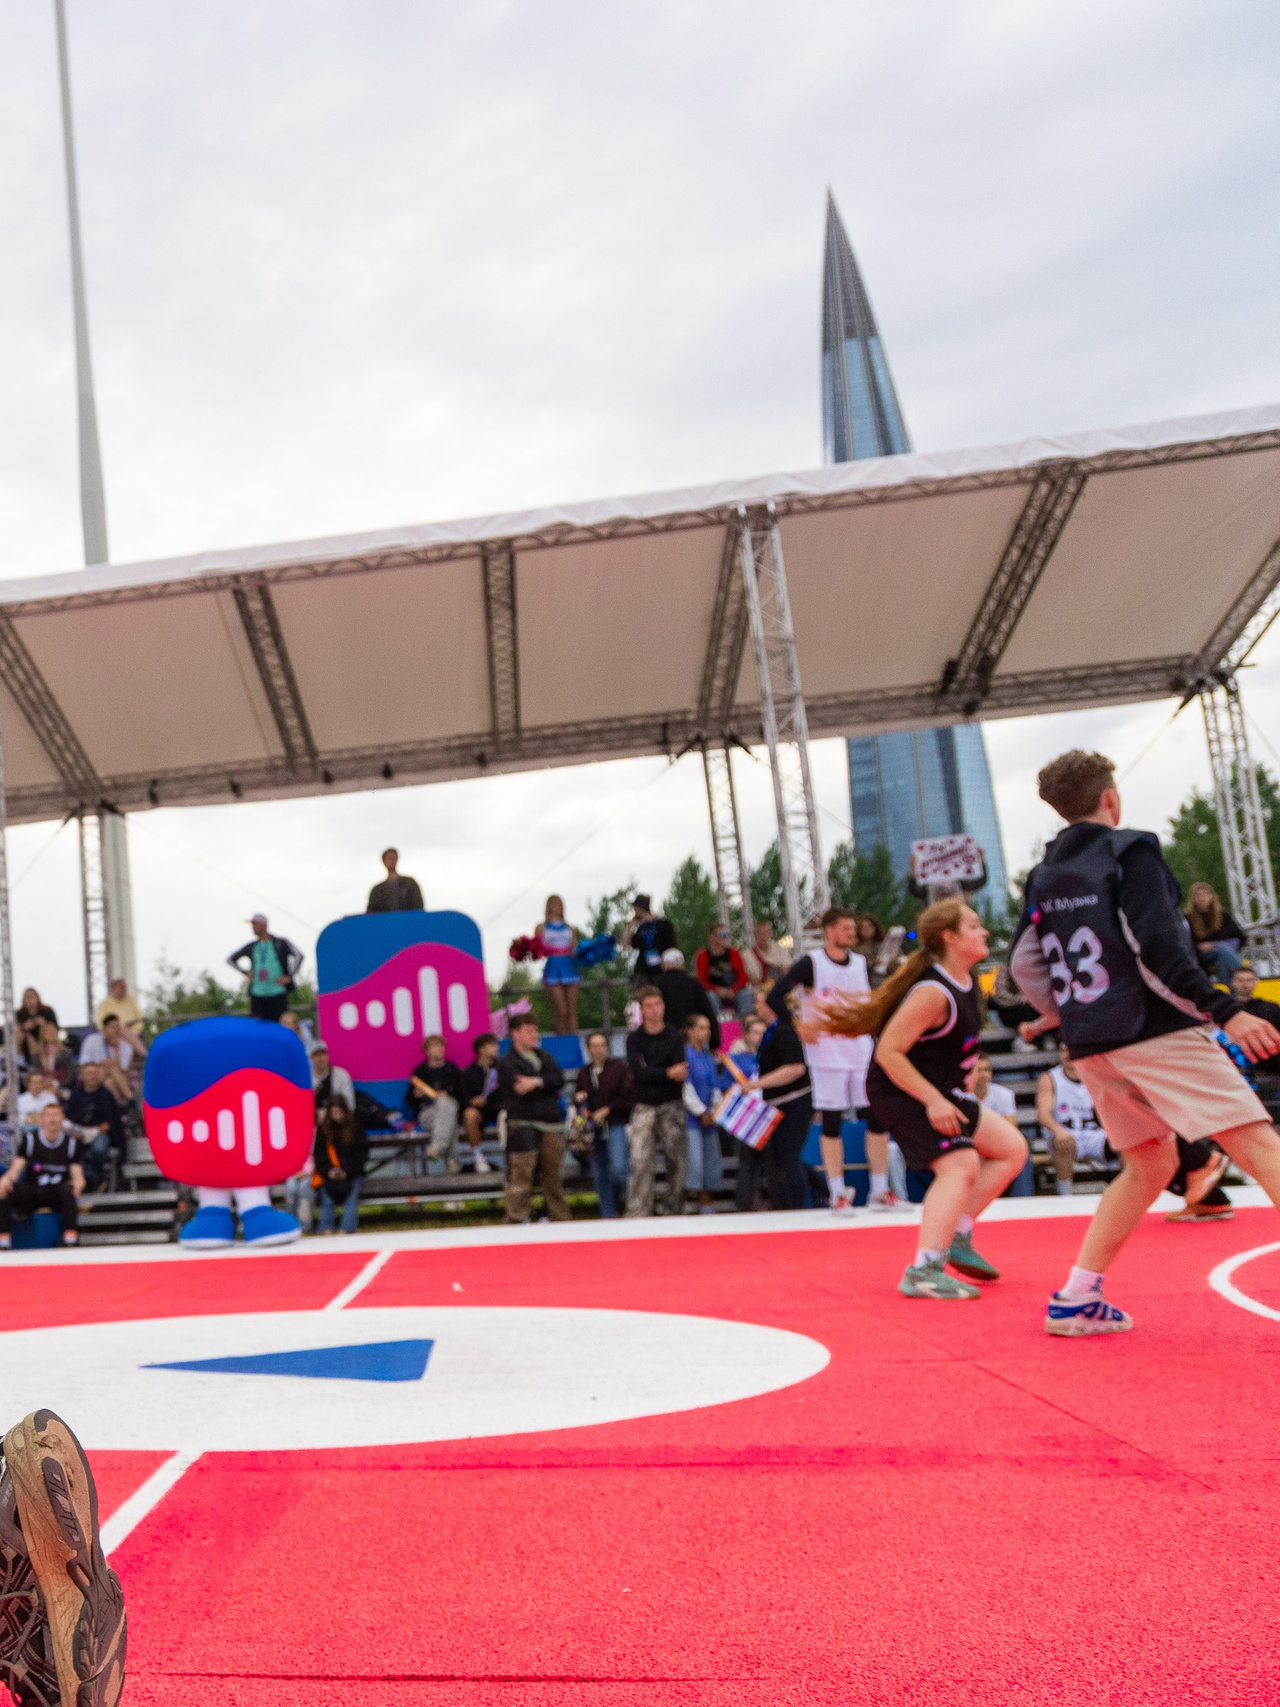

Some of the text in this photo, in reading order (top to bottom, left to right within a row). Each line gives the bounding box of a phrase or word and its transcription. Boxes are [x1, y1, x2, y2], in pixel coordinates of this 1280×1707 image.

[1040, 894, 1099, 913] VK Музыка
[1041, 926, 1110, 1007] 33
